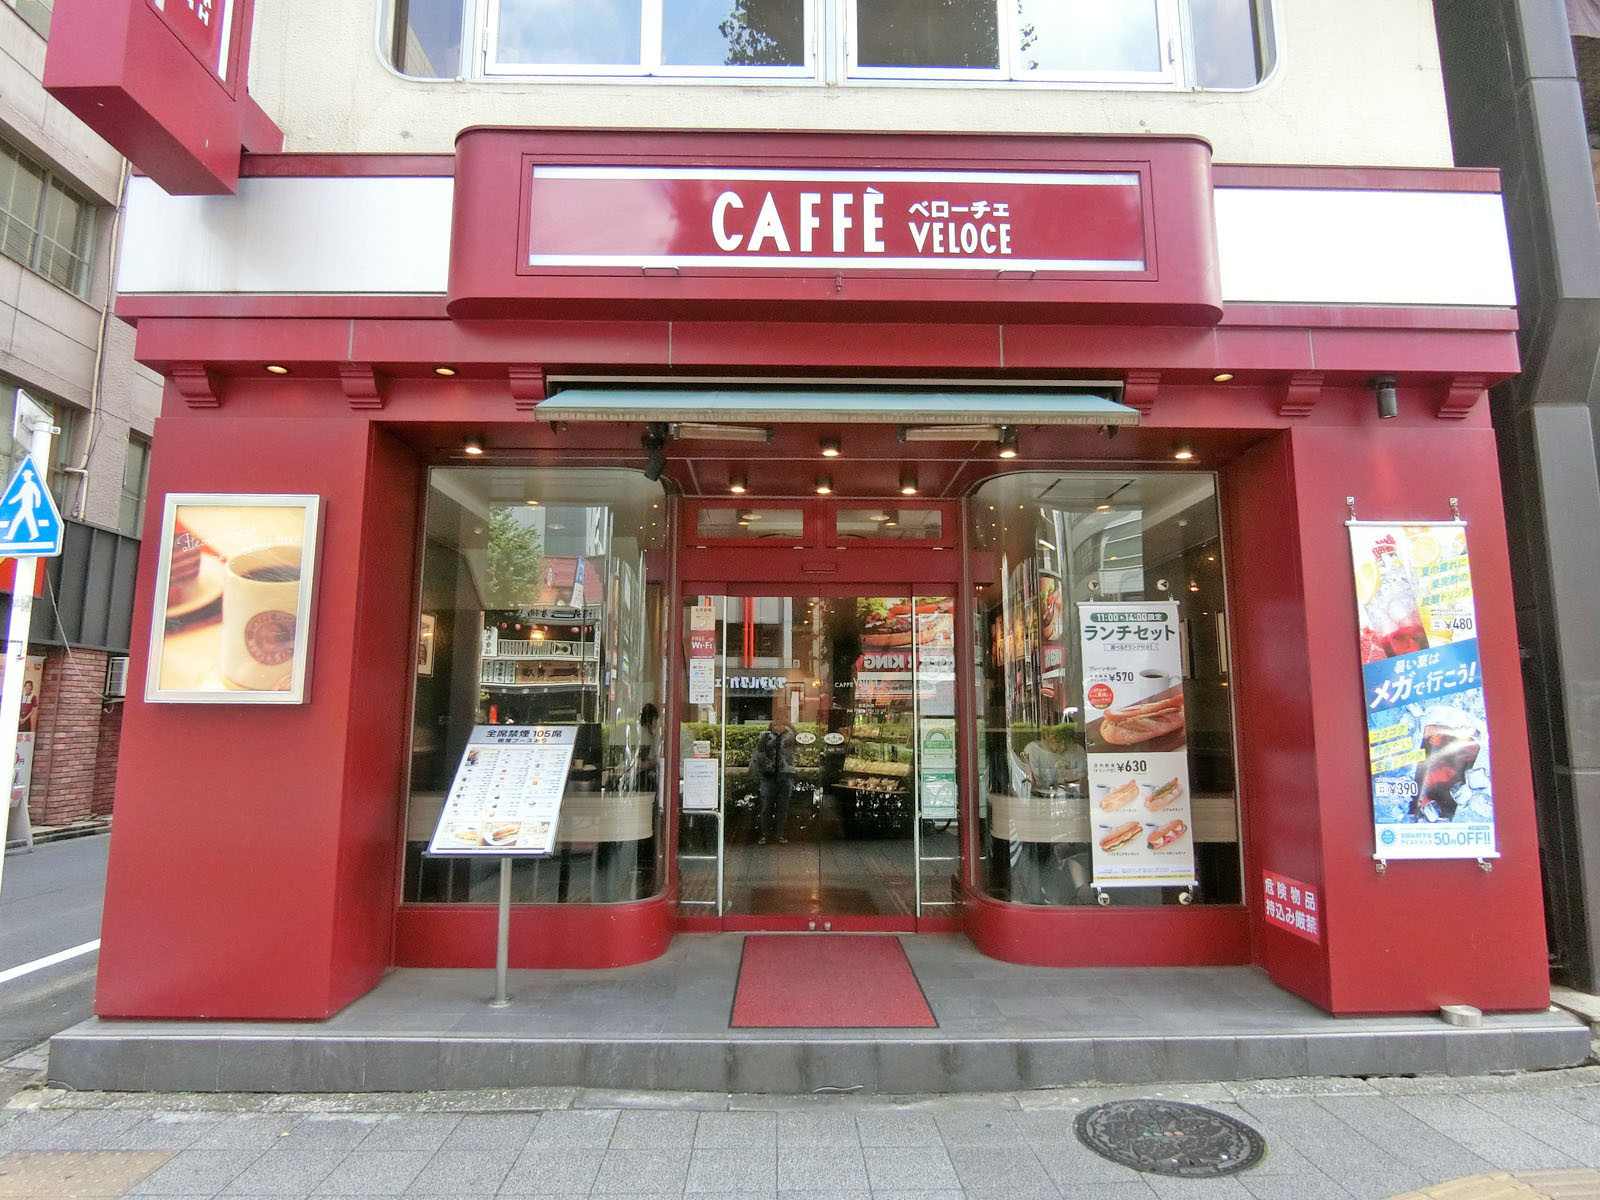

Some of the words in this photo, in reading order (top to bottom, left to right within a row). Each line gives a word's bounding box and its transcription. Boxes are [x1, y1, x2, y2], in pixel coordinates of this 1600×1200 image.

[711, 186, 885, 252] CAFFÈ
[908, 221, 1012, 254] VELOCE
[1444, 618, 1473, 630] ¥480
[1084, 625, 1176, 641] ランチセット
[691, 641, 713, 649] Wi-Fi
[1109, 671, 1134, 682] ¥570
[1369, 661, 1477, 709] メガで行こう!
[1116, 760, 1147, 773] ¥630
[1389, 783, 1418, 795] ¥390
[1264, 878, 1316, 911] 危険物品
